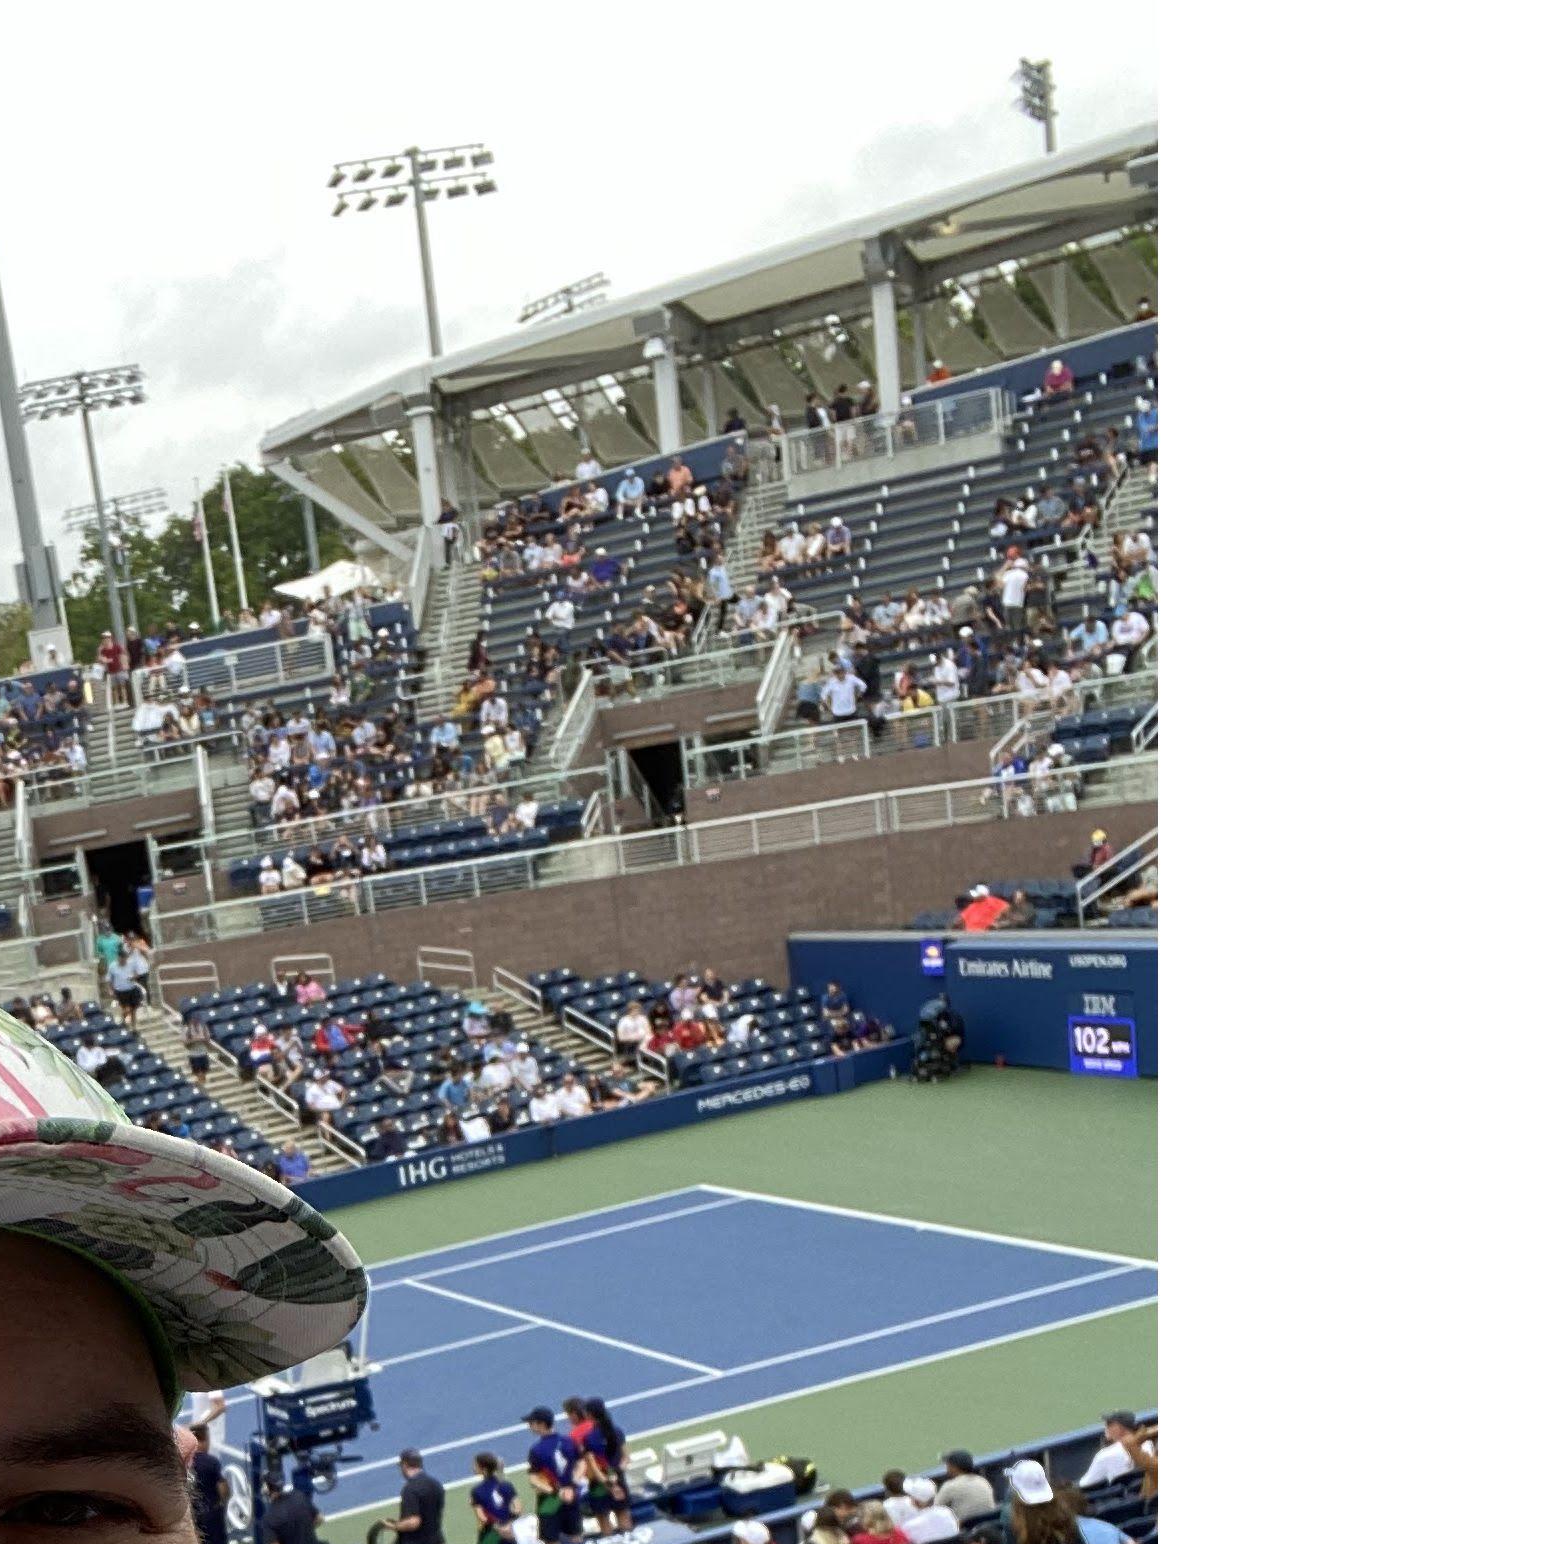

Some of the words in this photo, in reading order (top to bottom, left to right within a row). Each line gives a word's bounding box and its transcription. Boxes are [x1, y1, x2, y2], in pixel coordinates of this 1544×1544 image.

[1012, 958, 1054, 980] Airline
[1083, 993, 1116, 1017] IBM
[1073, 1026, 1110, 1055] 102
[399, 1156, 447, 1186] IHG
